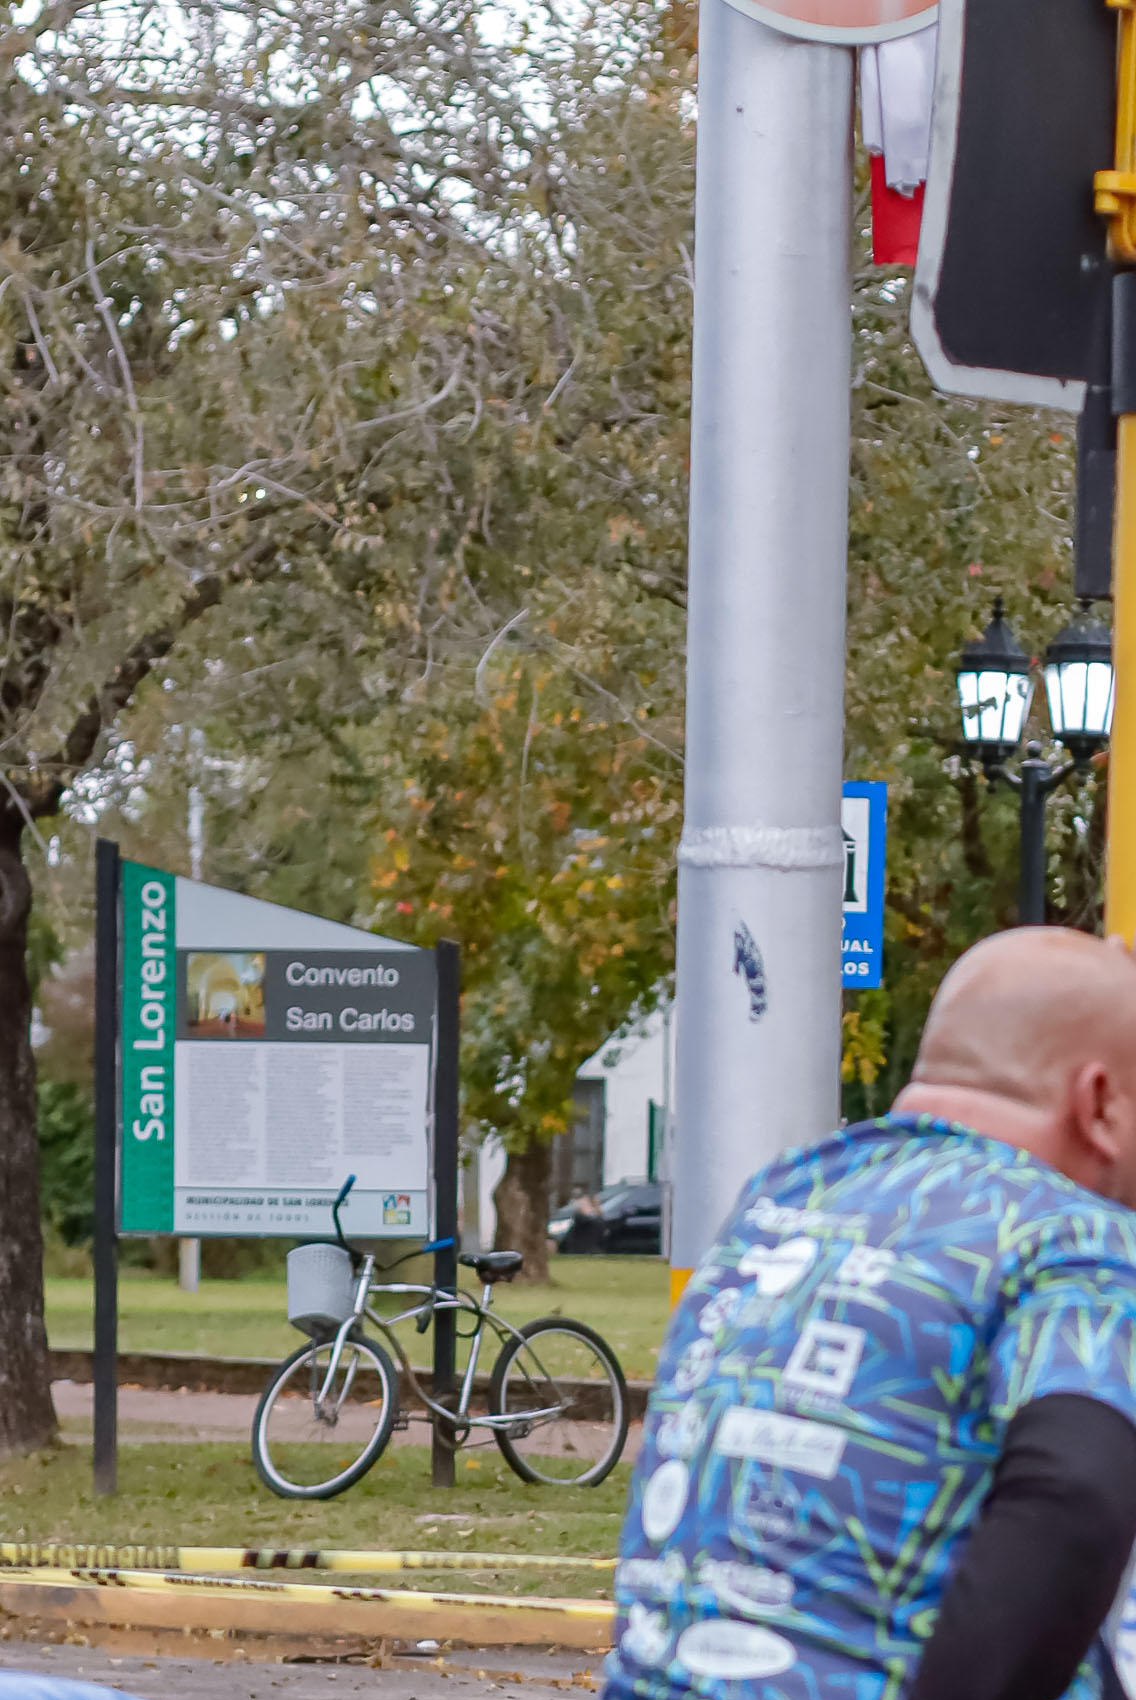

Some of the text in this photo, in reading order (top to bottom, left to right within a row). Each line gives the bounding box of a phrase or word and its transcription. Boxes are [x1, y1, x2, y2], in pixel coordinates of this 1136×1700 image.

[285, 961, 400, 988] Convento
[132, 879, 167, 1143] San Lorenzo
[285, 1006, 416, 1033] San Carlos
